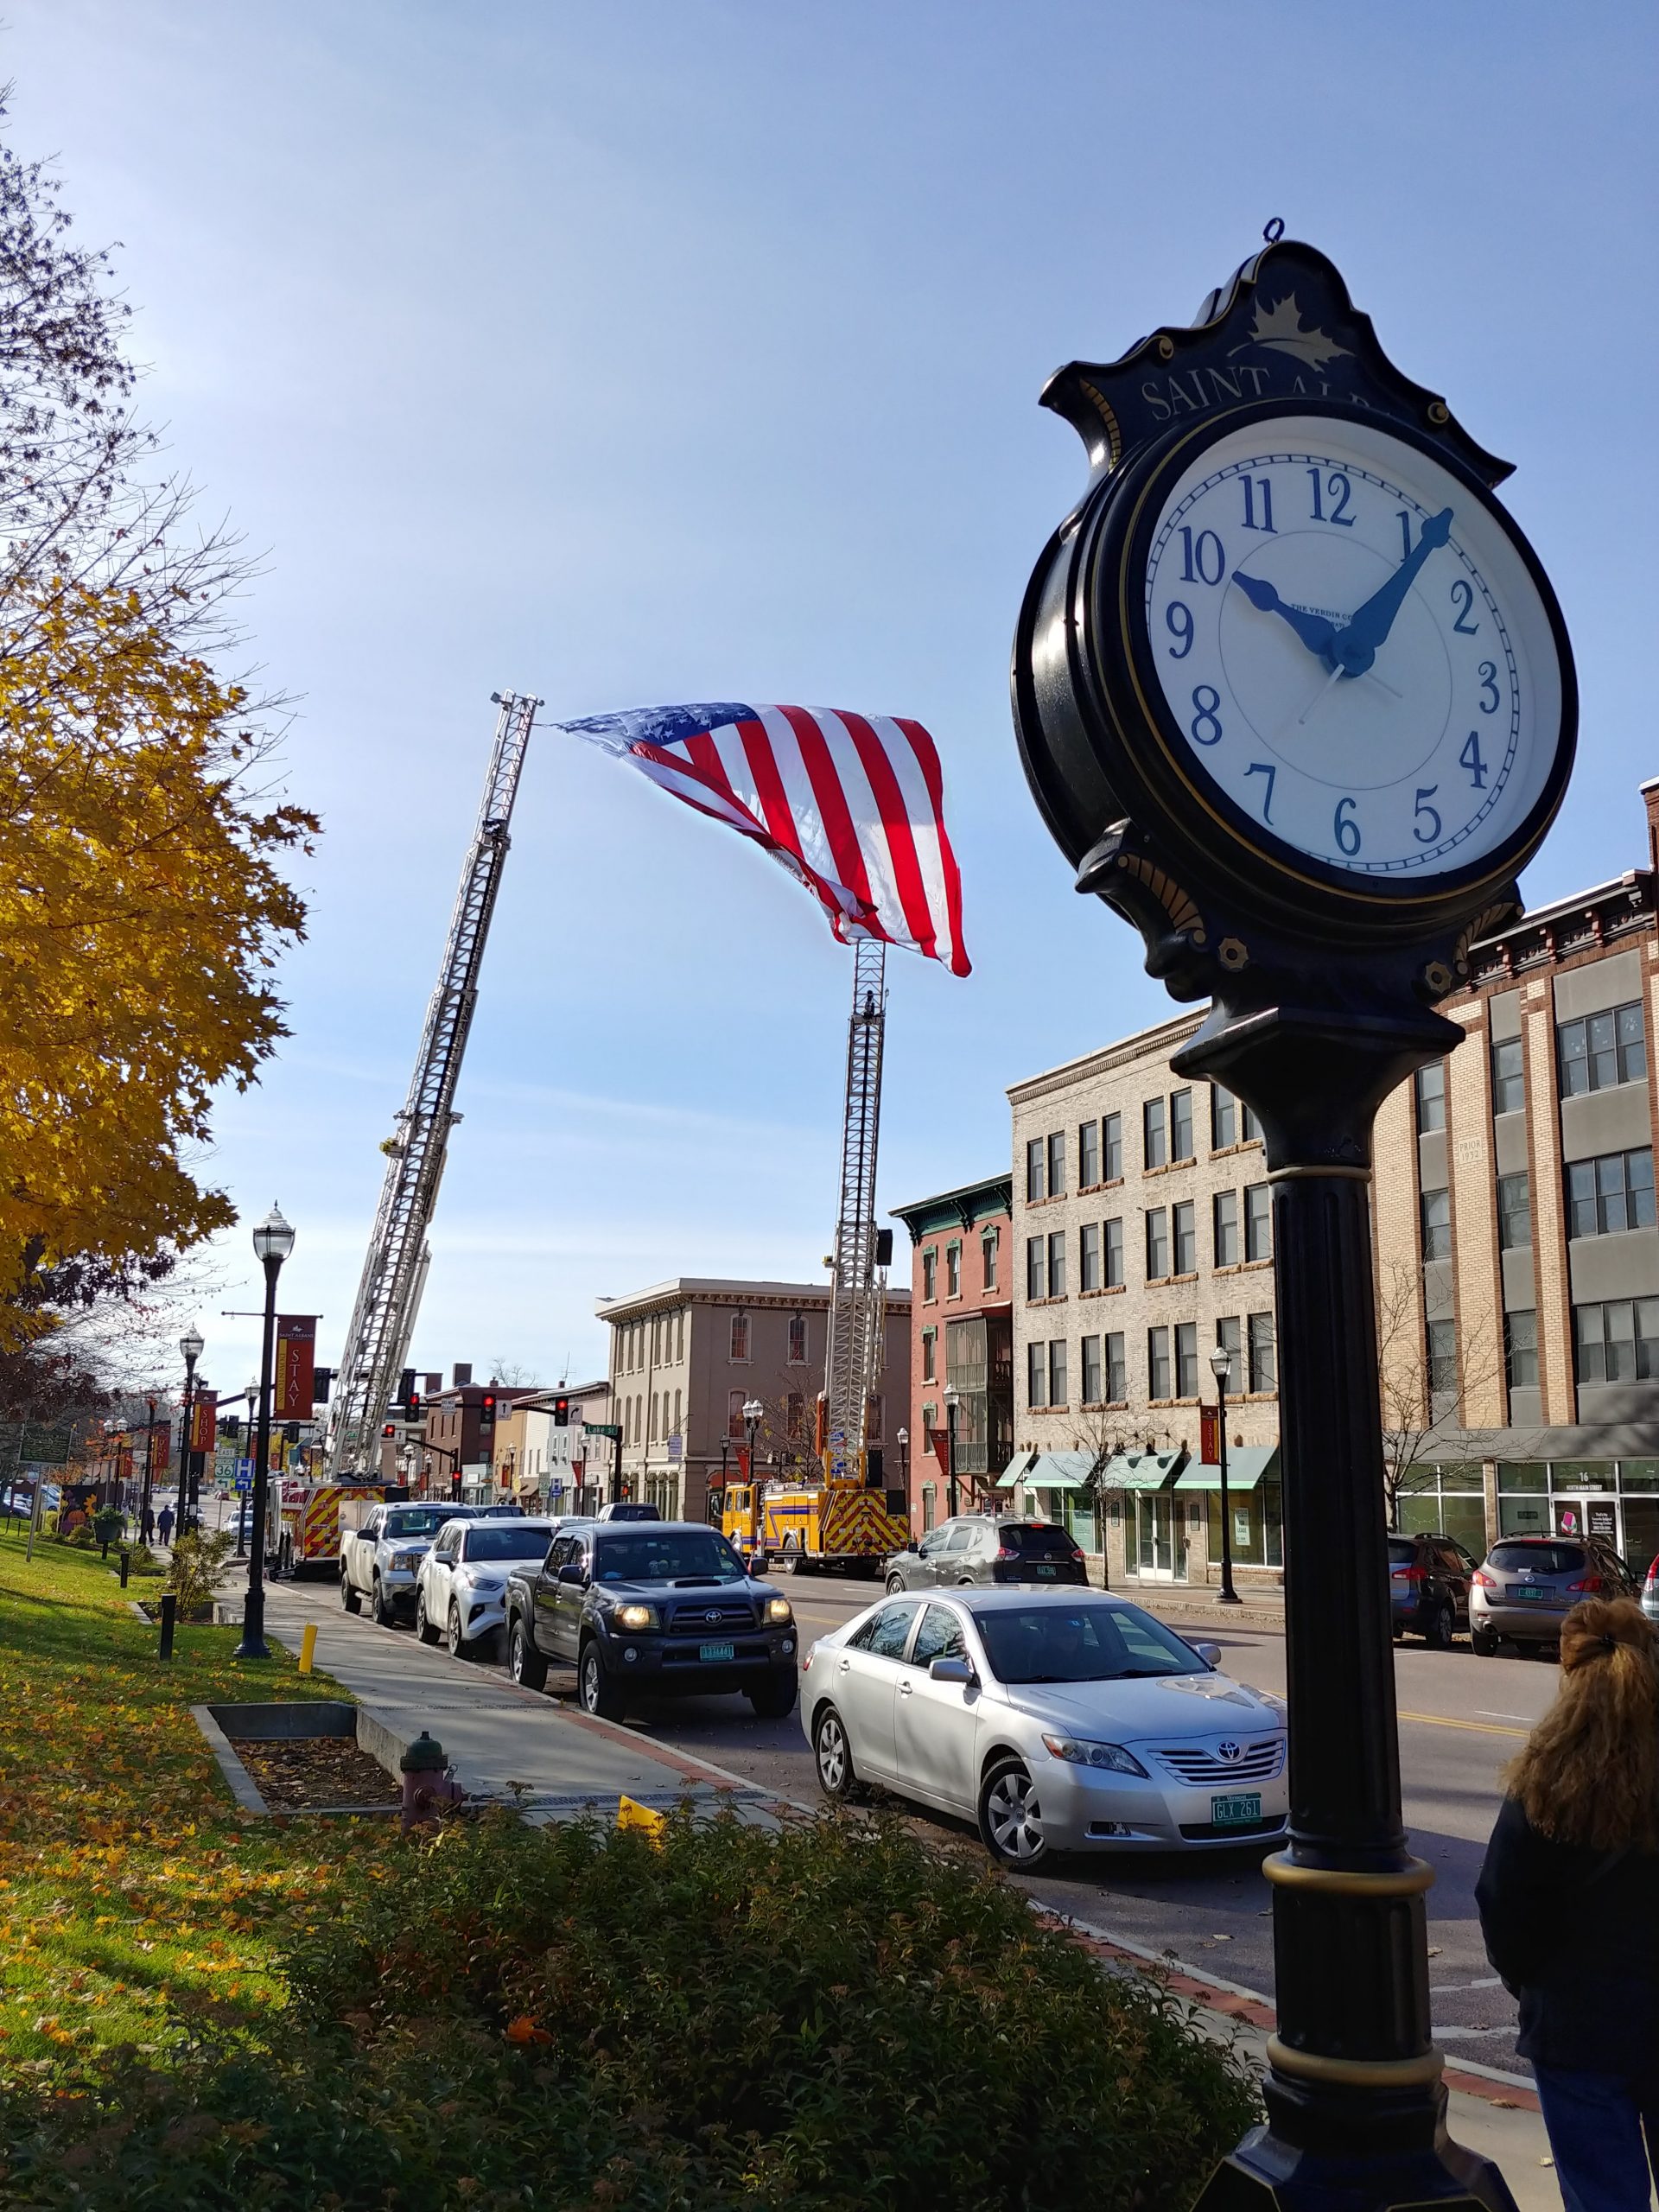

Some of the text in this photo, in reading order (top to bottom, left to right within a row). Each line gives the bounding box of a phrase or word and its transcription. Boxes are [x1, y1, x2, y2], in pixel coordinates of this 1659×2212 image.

[1141, 366, 1270, 422] SAINT
[1238, 474, 1278, 534] 11
[1306, 467, 1357, 526] 12
[1178, 525, 1225, 587] 10
[1395, 512, 1411, 563] 1
[1166, 601, 1194, 659] 9
[1309, 607, 1340, 619] VERDIN
[1451, 580, 1479, 636] 2
[1191, 684, 1223, 746] 8
[1478, 661, 1500, 715] 3
[1459, 730, 1487, 790] 4
[1243, 762, 1276, 826] 7
[1413, 784, 1442, 843] 5
[1333, 797, 1361, 856] 6
[1459, 1140, 1480, 1151] PRIOR
[289, 1349, 301, 1407] STAY
[200, 1409, 208, 1444] SHOP
[216, 1465, 232, 1476] 36
[236, 1459, 253, 1477] H
[1580, 1472, 1589, 1482] 16
[1217, 1801, 1258, 1819] GLX 261
